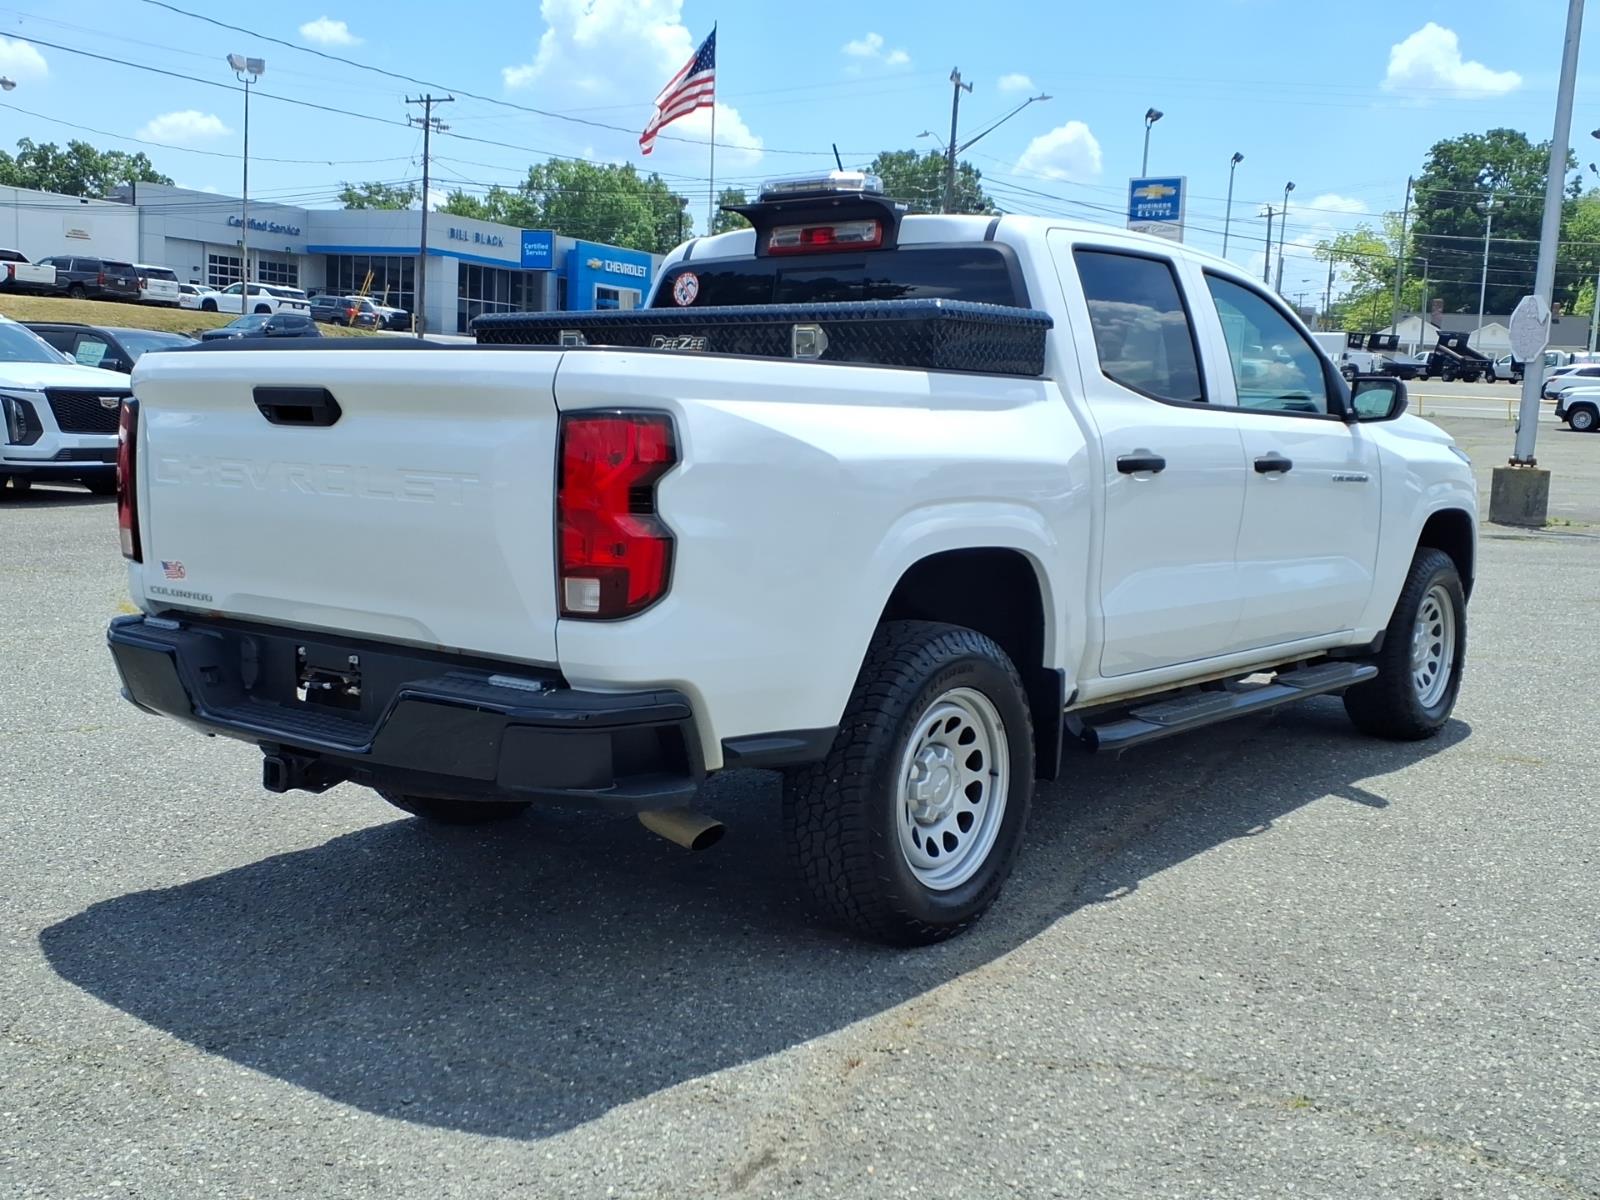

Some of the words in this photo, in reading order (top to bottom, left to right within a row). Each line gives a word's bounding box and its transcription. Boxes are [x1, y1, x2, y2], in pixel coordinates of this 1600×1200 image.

[228, 215, 267, 231] Cerified
[267, 221, 301, 236] Service
[449, 227, 469, 241] BILL
[474, 232, 504, 248] BLACK
[605, 260, 647, 277] CHEVROLET
[154, 456, 479, 506] CHEVROLET
[150, 586, 213, 602] COLORADO
